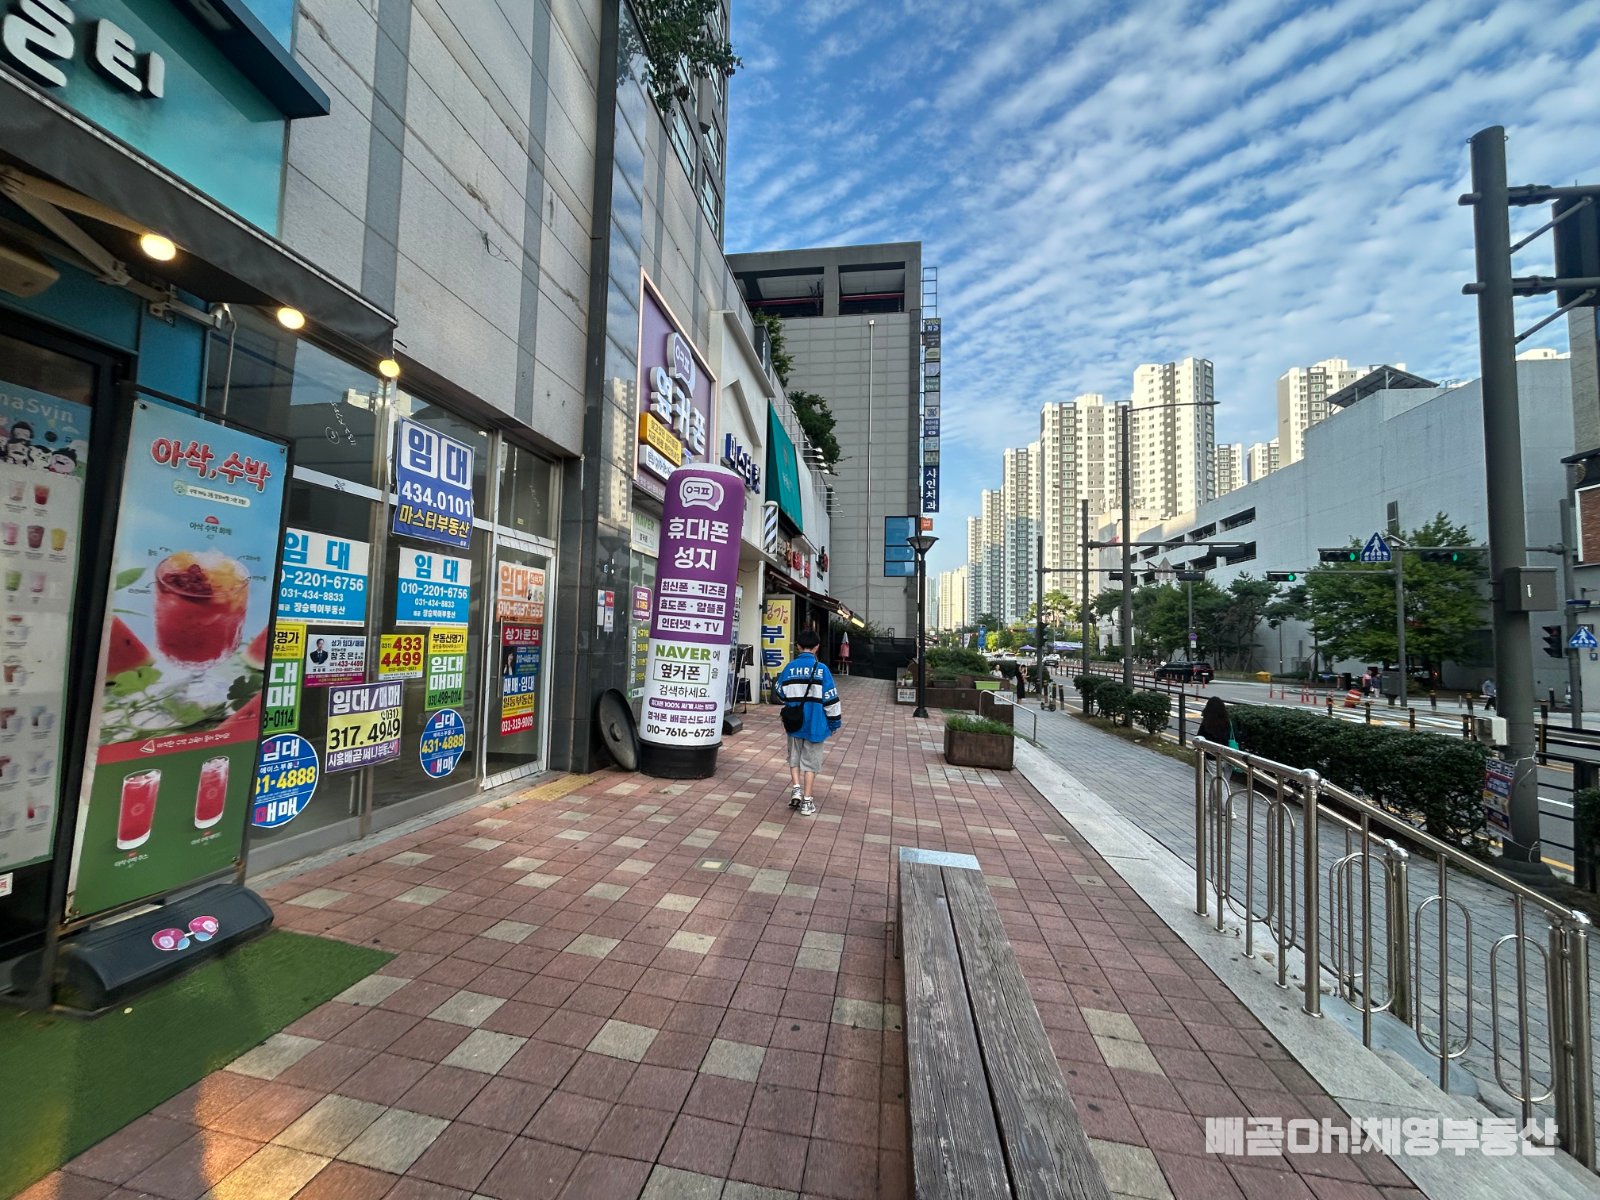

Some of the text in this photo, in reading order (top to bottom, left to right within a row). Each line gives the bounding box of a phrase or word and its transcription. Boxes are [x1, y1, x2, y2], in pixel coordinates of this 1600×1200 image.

[408, 427, 468, 486] 임대
[401, 480, 471, 518] 434.0101
[399, 504, 470, 538] 마스터부동산
[668, 516, 729, 544] 휴대폰
[674, 546, 717, 571] 성지
[401, 581, 468, 599] 010-2201-6756
[501, 565, 529, 598] 임대
[661, 581, 726, 597] 최신폰 키즈폰
[281, 587, 344, 602] 031-434-8833
[661, 618, 691, 630] 인터넷
[704, 622, 720, 632] TV
[275, 631, 299, 644] 명가
[505, 628, 539, 640] 상가문의
[381, 652, 421, 667] 4499
[656, 644, 711, 661] NAVER
[431, 656, 464, 673] 임대
[661, 663, 700, 681] 옆커폰
[429, 673, 463, 691] 매매
[664, 701, 680, 709] 100%
[434, 713, 455, 729] 임대
[646, 724, 715, 738] 010-7616-6725
[263, 738, 300, 762] 임대
[430, 756, 454, 773] 매매
[255, 797, 298, 823] 매매
